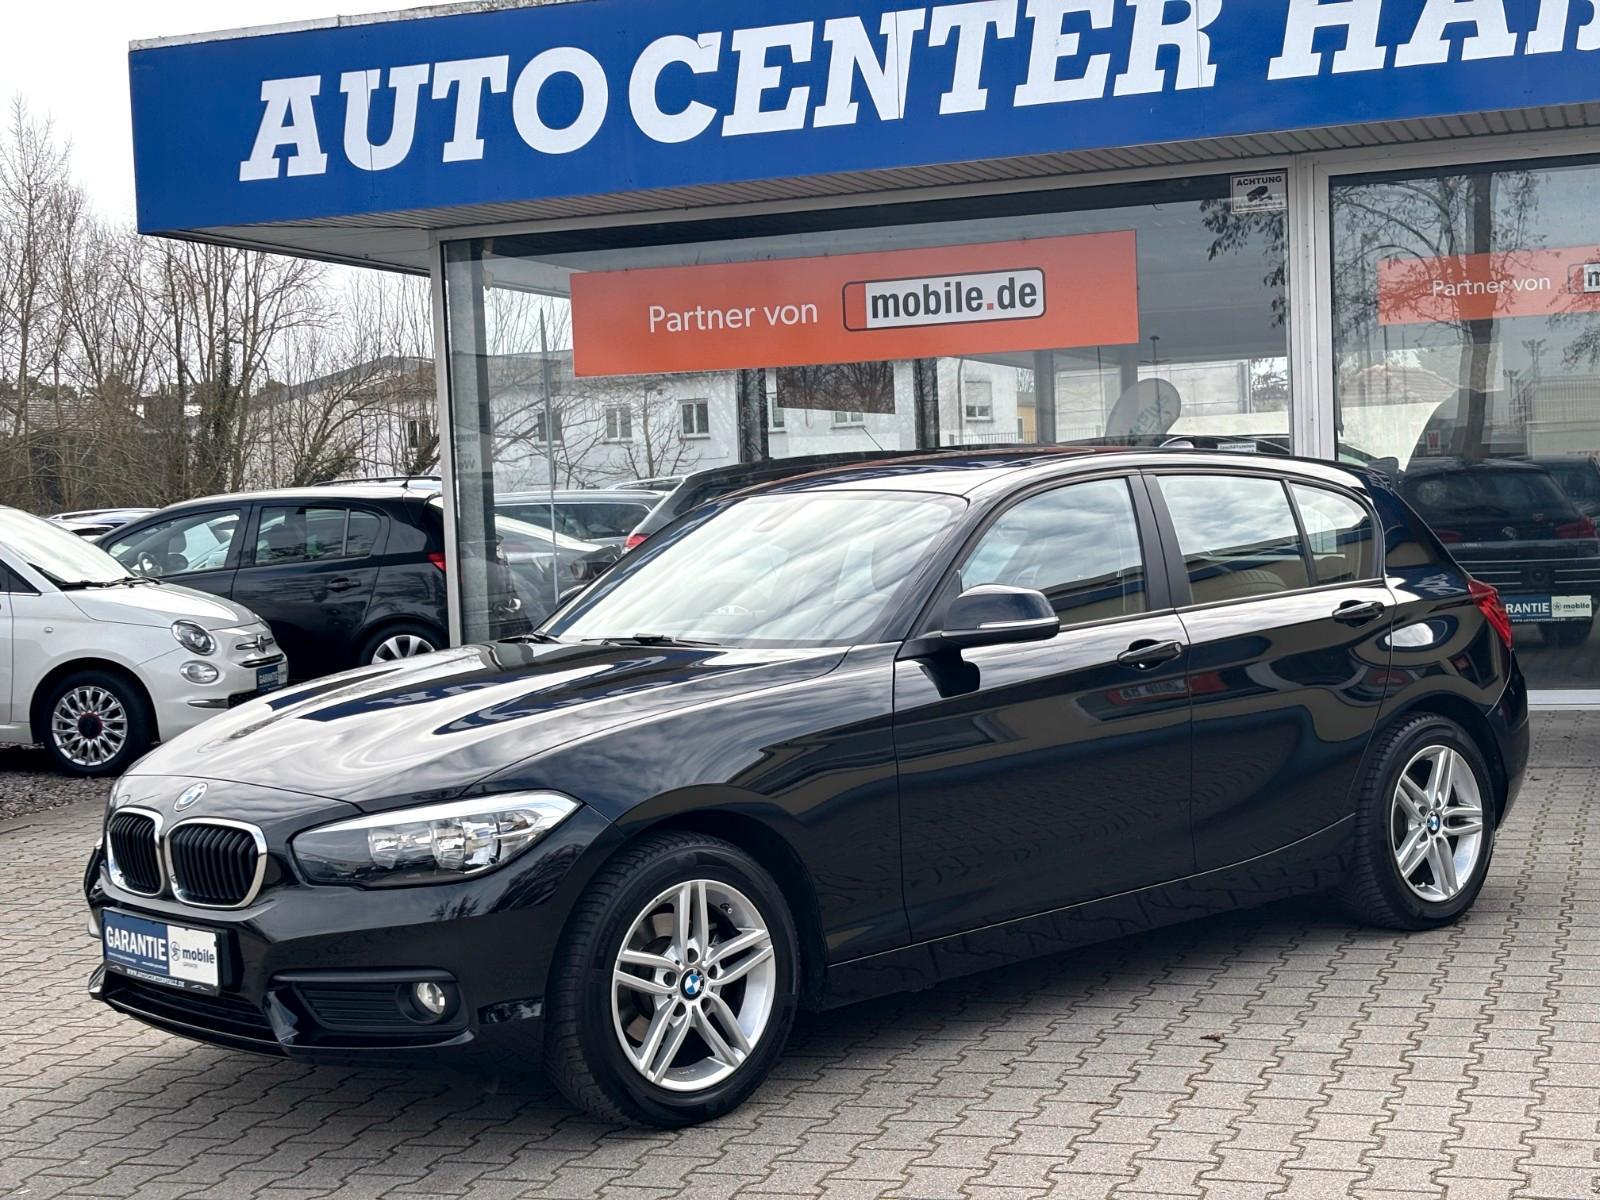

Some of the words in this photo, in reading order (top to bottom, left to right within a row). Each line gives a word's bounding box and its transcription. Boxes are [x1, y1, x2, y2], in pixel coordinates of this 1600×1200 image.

[1236, 175, 1282, 186] ACHTUNG
[1432, 278, 1506, 297] Partner
[1513, 276, 1551, 292] von
[649, 304, 756, 333] Partner
[763, 302, 818, 327] von
[871, 277, 1038, 319] mobile.de
[1505, 602, 1550, 614] RANTIE
[106, 926, 167, 961] GARANTIE
[182, 948, 215, 964] mobile
